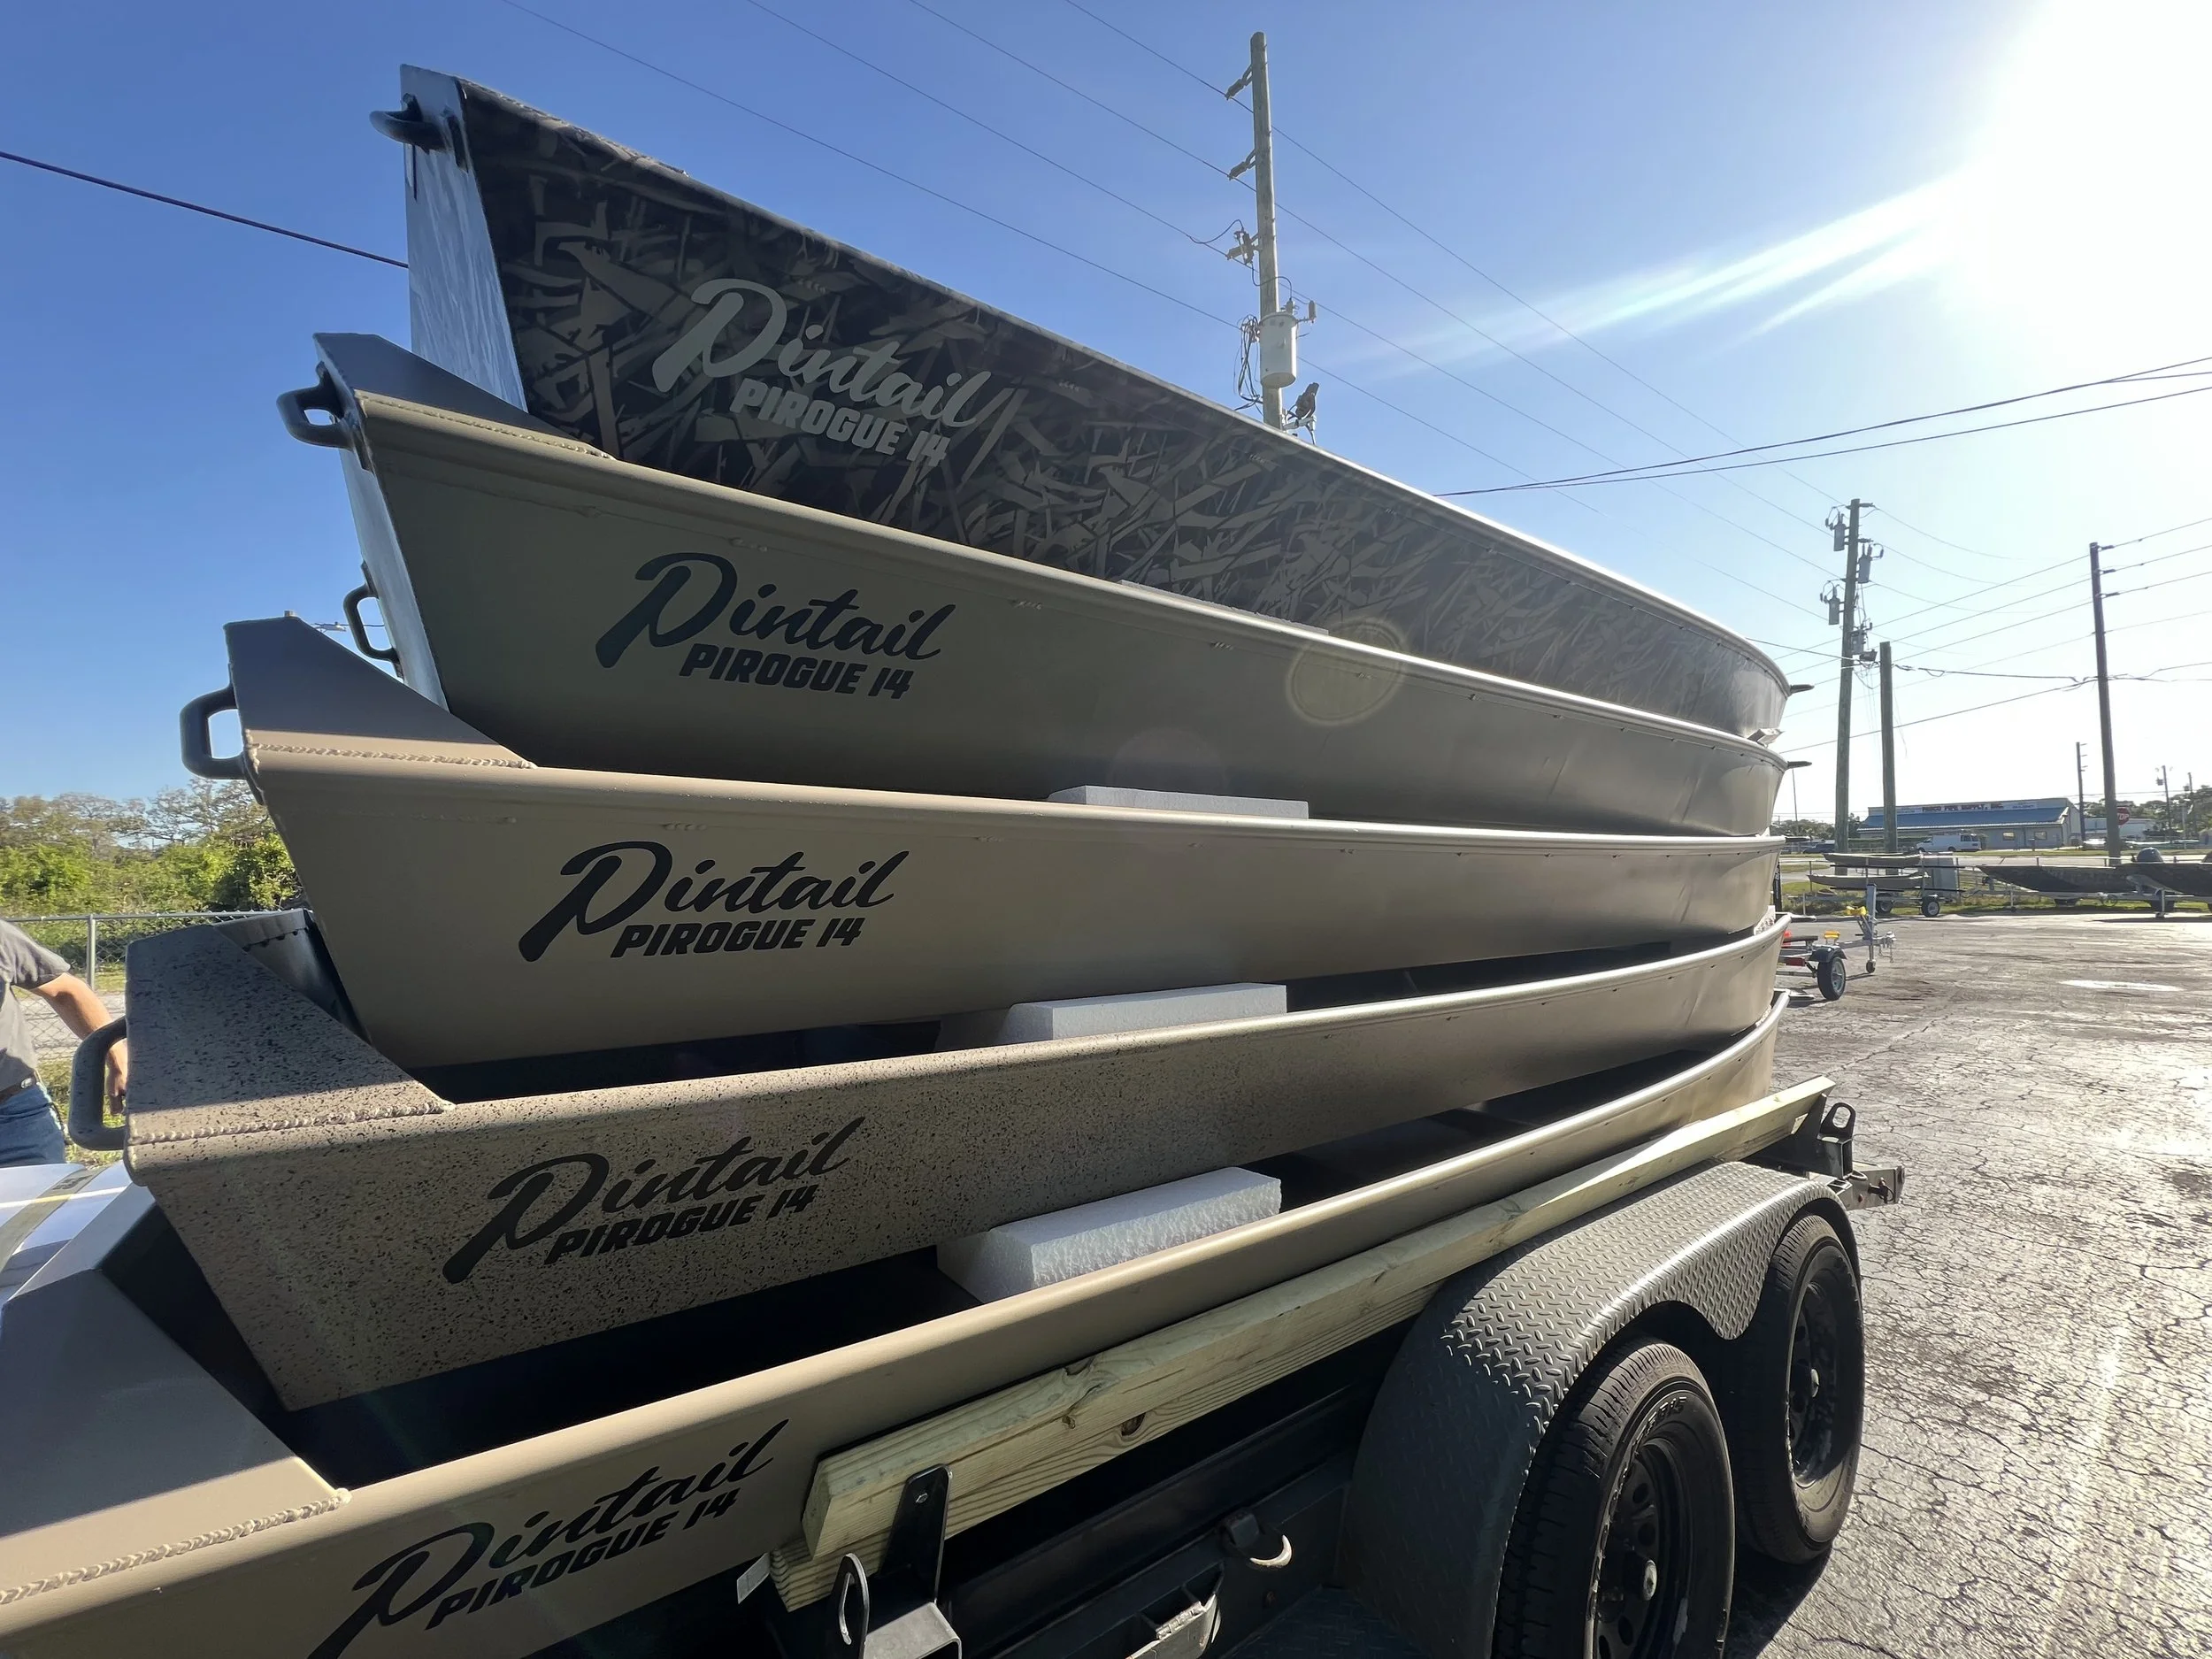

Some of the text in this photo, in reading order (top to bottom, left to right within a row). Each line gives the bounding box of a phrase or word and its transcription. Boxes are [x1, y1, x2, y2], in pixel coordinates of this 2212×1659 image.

[651, 278, 992, 427] Pintail
[729, 378, 951, 468] PIROGUE 14
[595, 552, 956, 669] Pintail
[679, 642, 915, 700] PIROGUE 14
[518, 841, 910, 963] Pintail
[609, 917, 866, 958] PIROGUE 14
[442, 1116, 866, 1284] Pintail
[543, 1183, 819, 1265] PIROGUE 14
[306, 1418, 790, 1659] Pintail
[424, 1486, 741, 1632] PIROGUE 14
